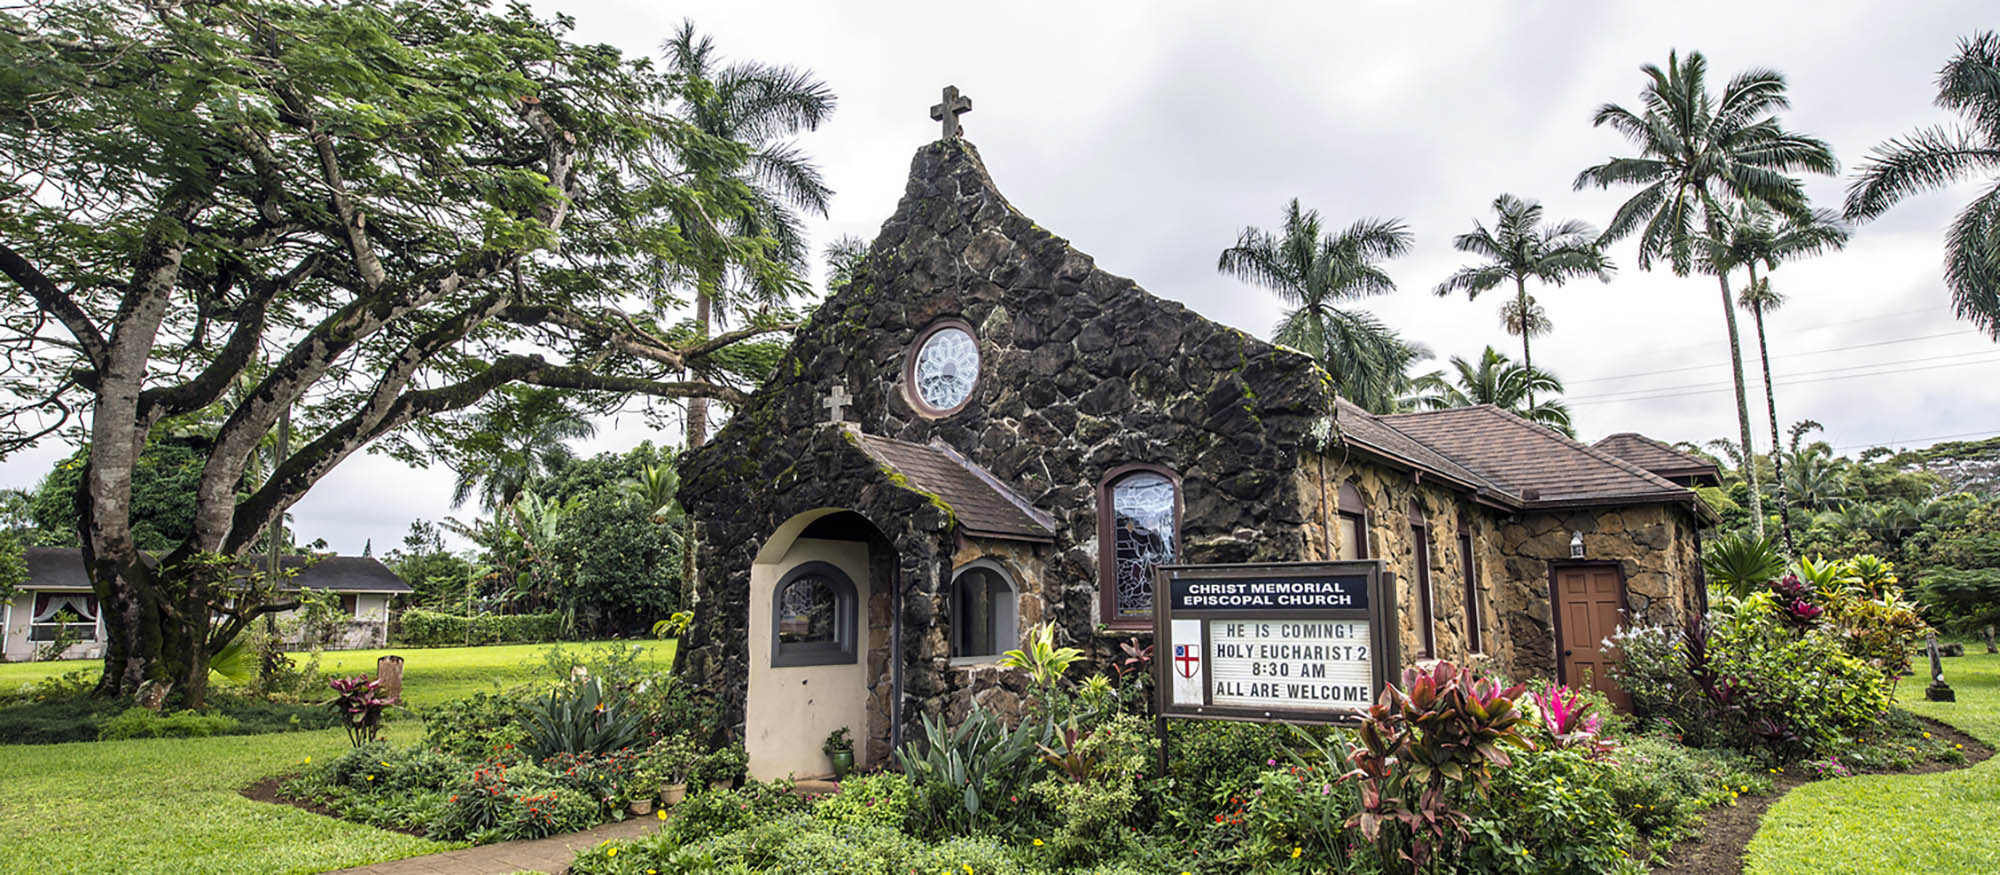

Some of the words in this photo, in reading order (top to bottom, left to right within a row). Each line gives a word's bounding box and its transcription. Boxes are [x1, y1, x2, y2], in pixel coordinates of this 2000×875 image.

[1188, 584, 1247, 594] CHRIST
[1250, 583, 1344, 593] MEMORIAL
[1183, 595, 1273, 605] EPISCOPAL
[1278, 594, 1351, 605] CHURCH
[1227, 624, 1245, 638] HE
[1255, 624, 1270, 638] IS
[1281, 624, 1354, 638] COMING!
[1217, 644, 1254, 658] HOLY
[1261, 645, 1352, 661] EUCHARIST
[1357, 646, 1367, 661] 2
[1252, 663, 1289, 677] 8:30
[1300, 664, 1326, 678] AM
[1216, 682, 1244, 696] ALL
[1250, 683, 1279, 698] ARE
[1287, 684, 1368, 702] WELCOME
